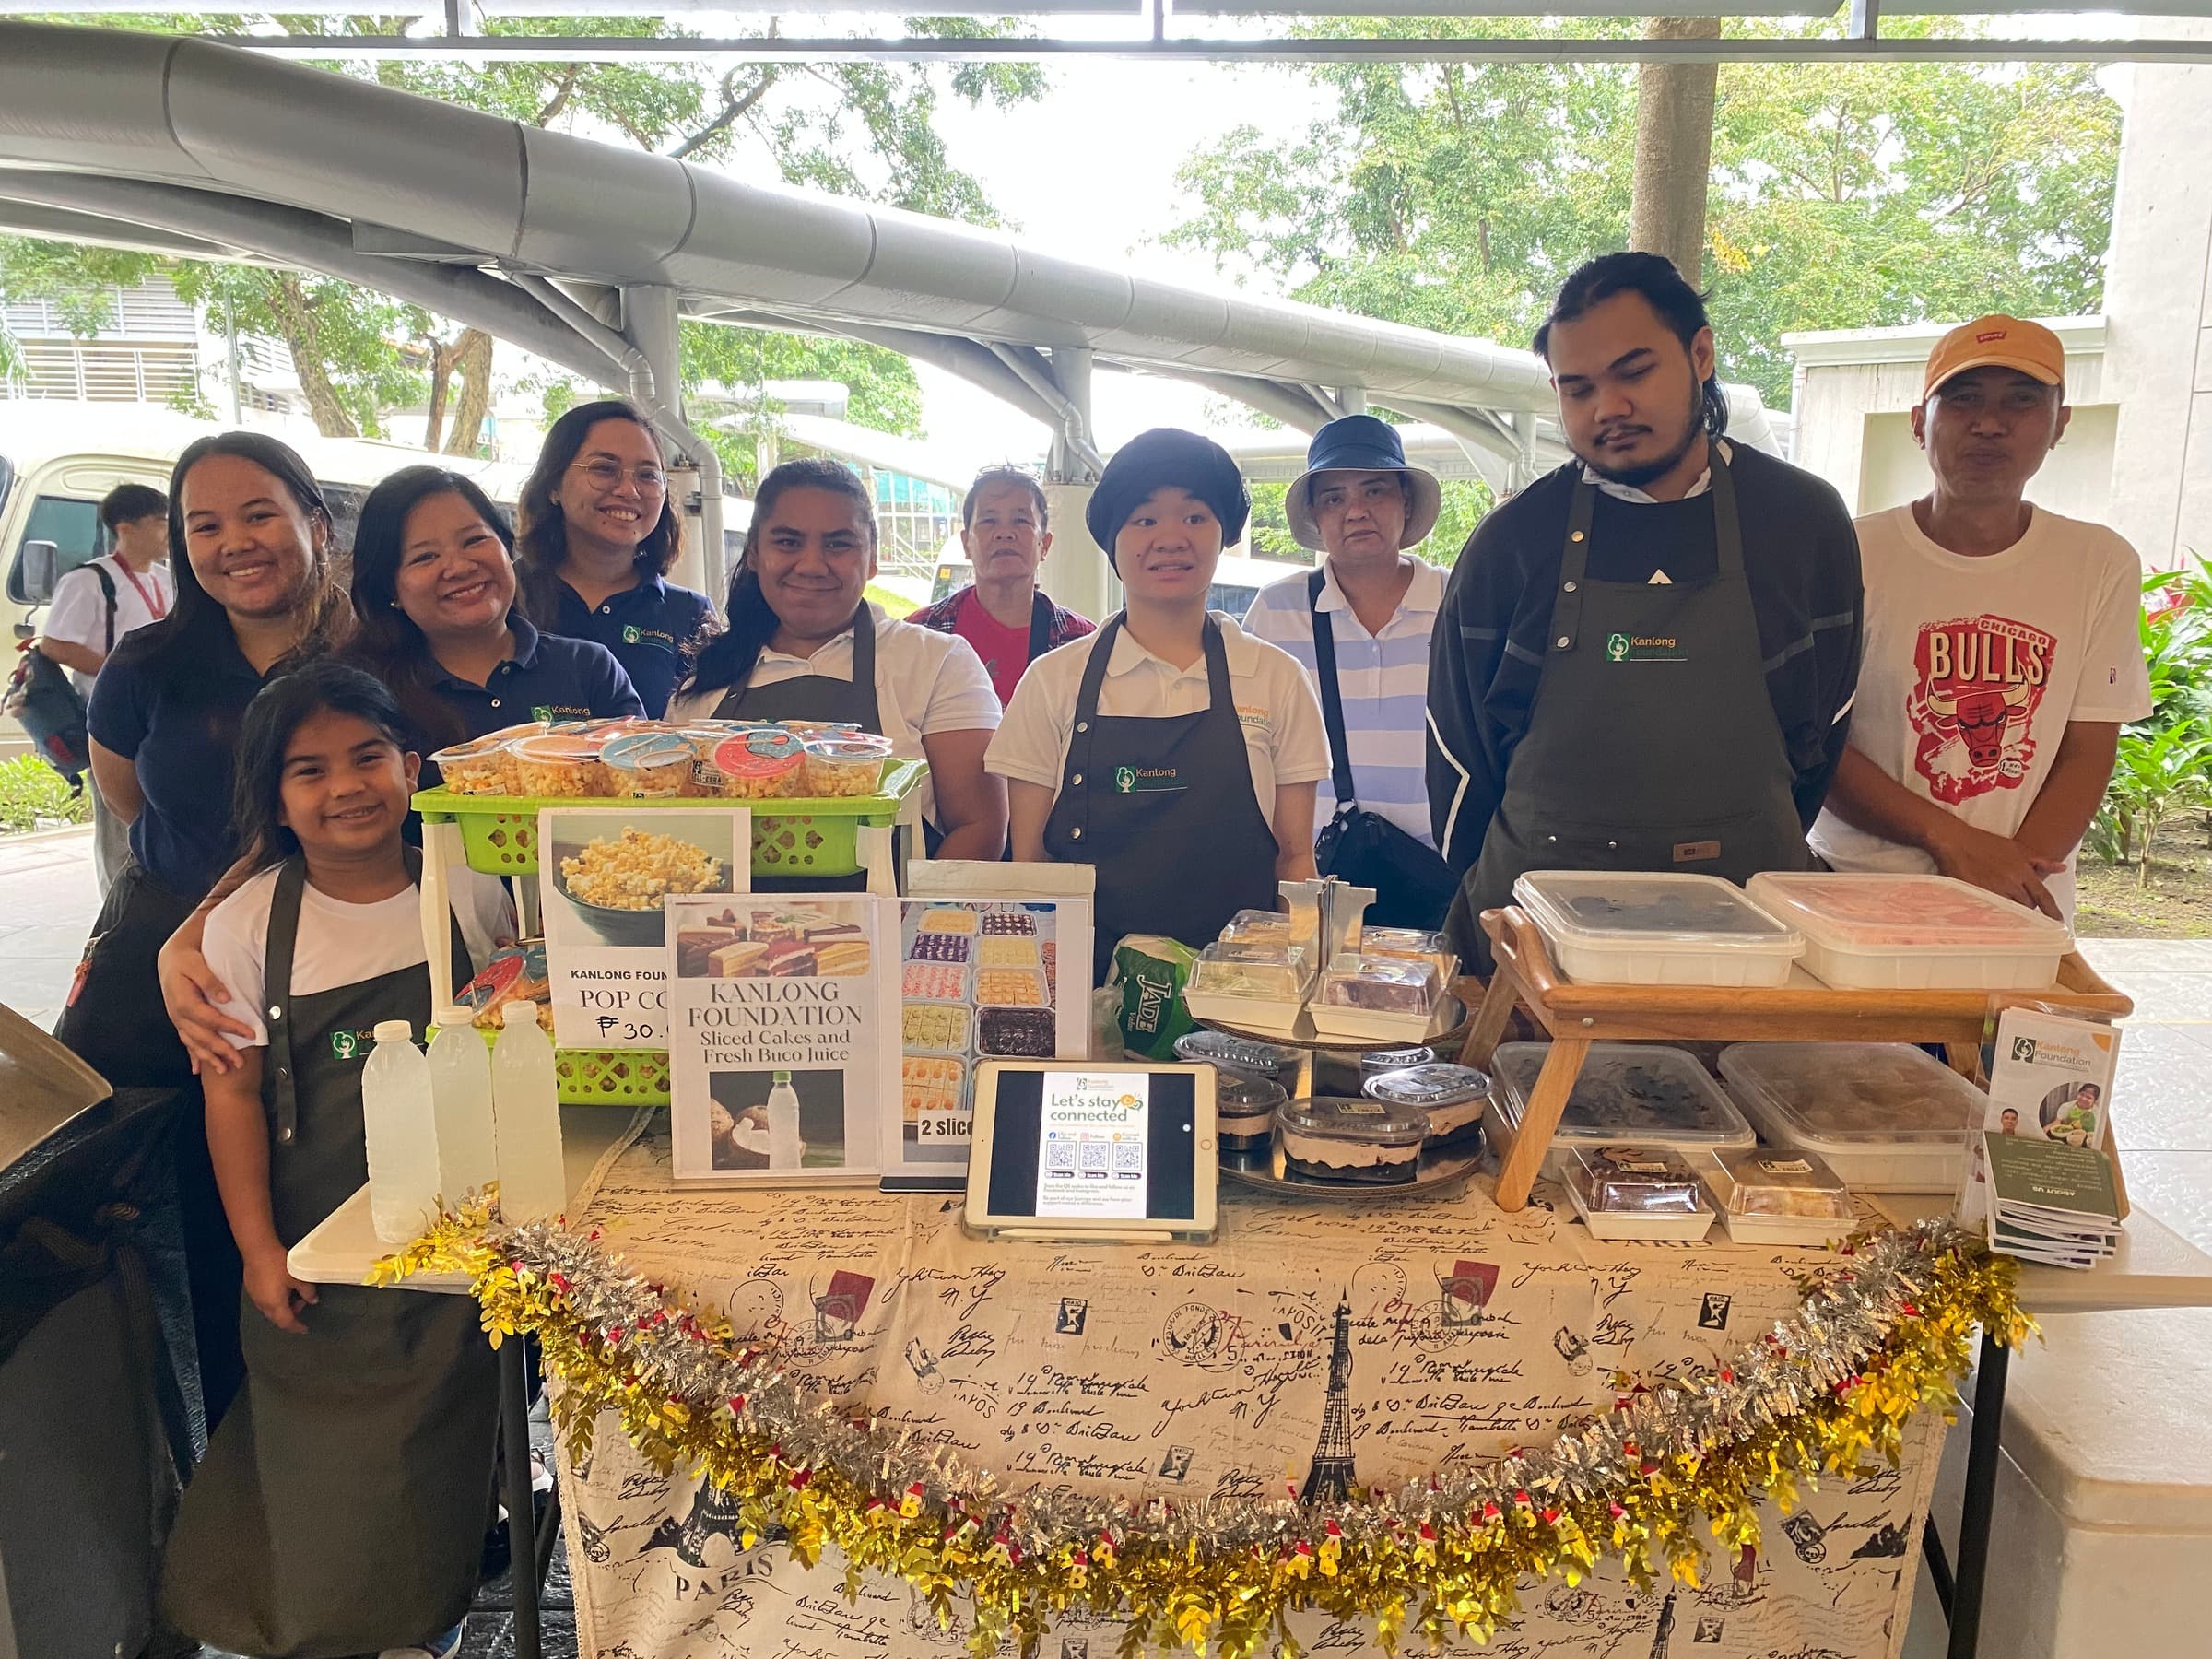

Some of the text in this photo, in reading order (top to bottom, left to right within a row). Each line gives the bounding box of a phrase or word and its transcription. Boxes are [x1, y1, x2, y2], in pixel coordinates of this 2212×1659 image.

[640, 629, 675, 643] Kanlong
[1980, 619, 2047, 645] CHICAGO
[1630, 636, 1676, 648] Kanlong
[1930, 632, 2044, 686] BULLS
[552, 705, 591, 716] Kanlong
[1135, 768, 1177, 778] Kanlong
[571, 970, 632, 980] KANLONG
[579, 989, 631, 1010] POP
[711, 982, 839, 1004] KANLONG
[1136, 974, 1172, 1033] JADE
[688, 1006, 863, 1028] FOUNDATION
[700, 1029, 851, 1046] Sliced Cakes and
[703, 1047, 850, 1064] Fresh Buco Juice
[2034, 1050, 2092, 1067] Foundation
[1051, 1093, 1122, 1112] Let's stay
[1051, 1108, 1128, 1122] connected
[921, 1119, 932, 1135] 2
